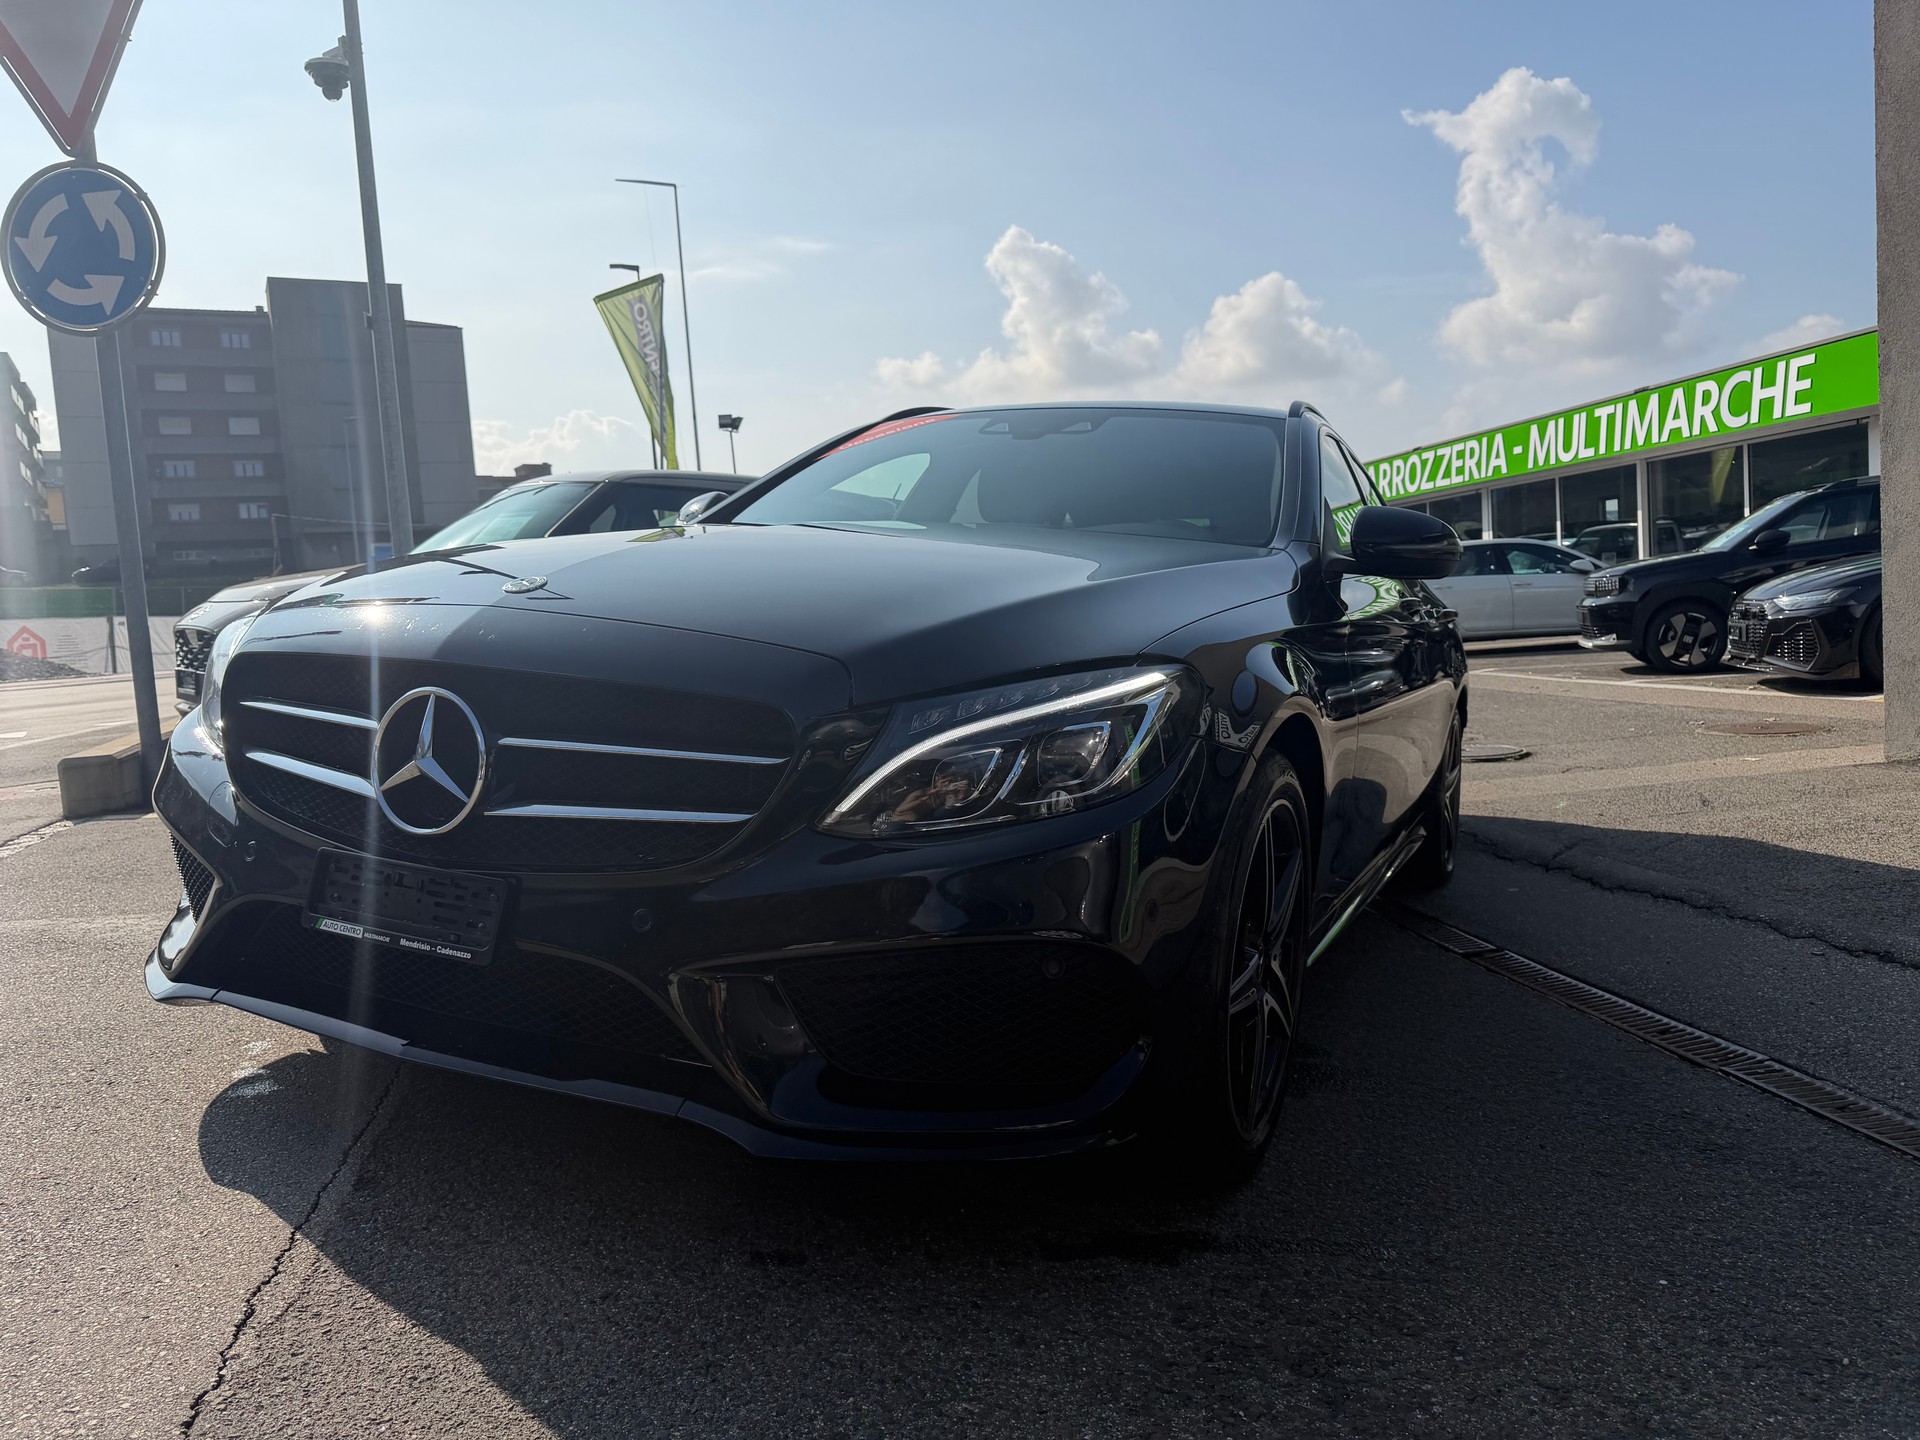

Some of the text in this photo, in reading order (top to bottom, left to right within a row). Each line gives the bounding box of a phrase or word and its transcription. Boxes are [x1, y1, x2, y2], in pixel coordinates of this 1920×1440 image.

[1527, 353, 1816, 469] MULTIMARCHE
[839, 418, 936, 450] Occasione
[323, 921, 339, 930] AUTO
[339, 924, 361, 936] CENTRO
[400, 938, 431, 951] Mendrisio
[436, 945, 472, 959] Cadenazzo
